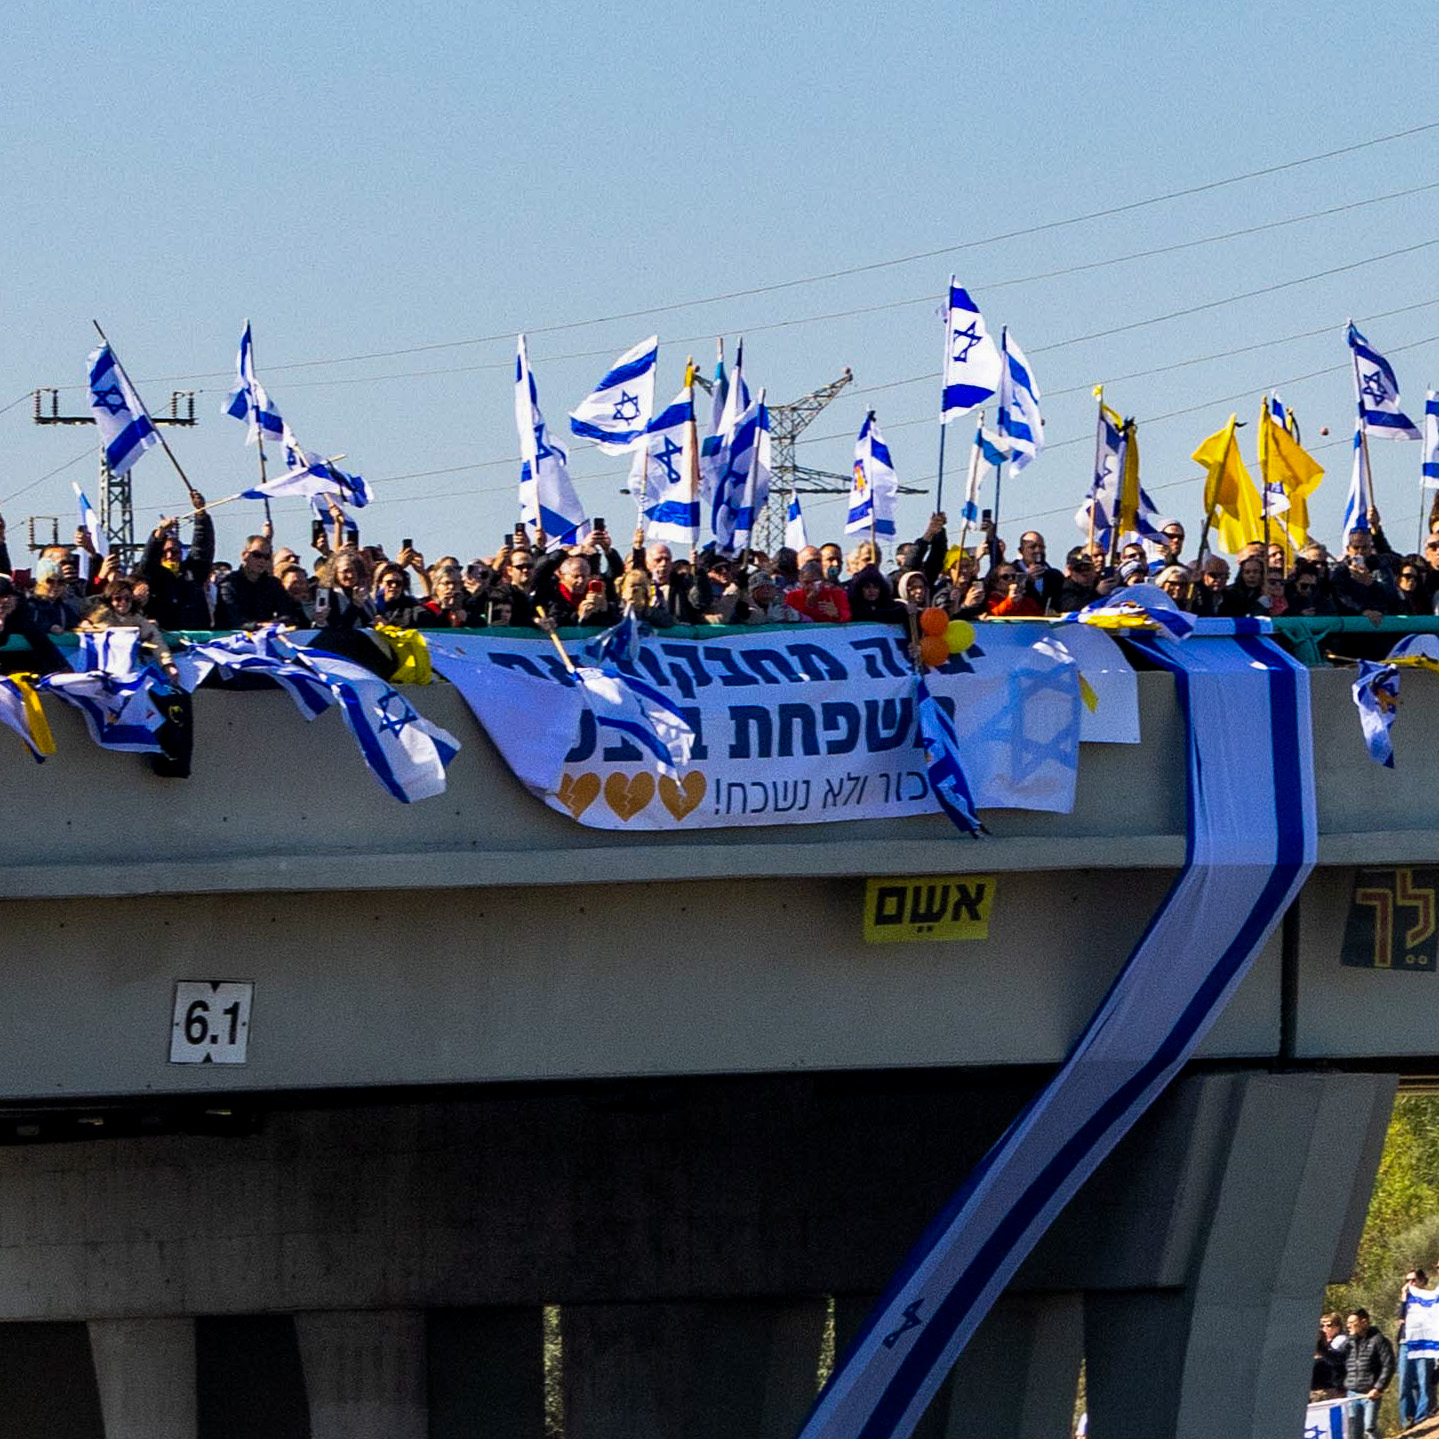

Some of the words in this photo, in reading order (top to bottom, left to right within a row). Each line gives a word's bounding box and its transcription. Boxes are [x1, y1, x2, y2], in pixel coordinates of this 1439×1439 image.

[714, 778, 810, 816] נשכח!
[822, 771, 869, 810] ולא
[184, 1001, 242, 1046] 6.1
